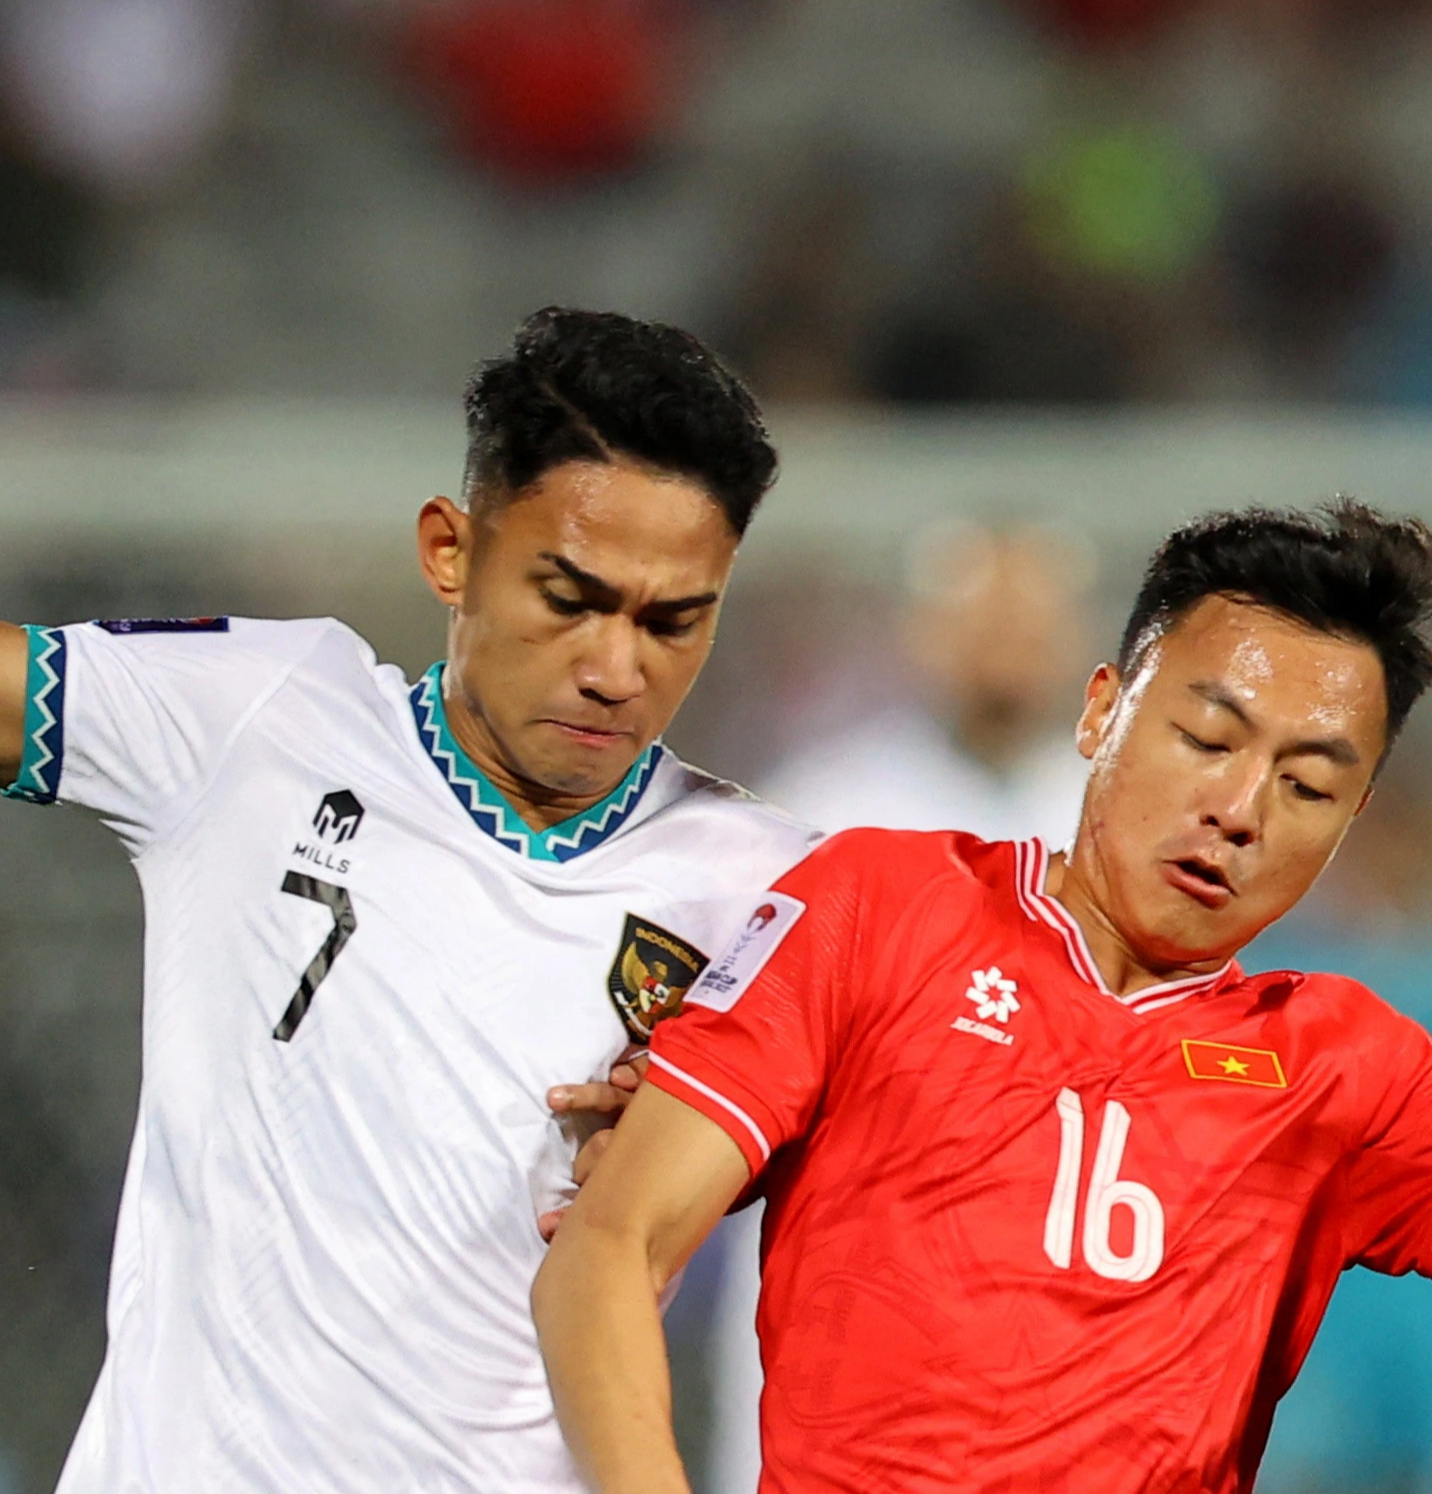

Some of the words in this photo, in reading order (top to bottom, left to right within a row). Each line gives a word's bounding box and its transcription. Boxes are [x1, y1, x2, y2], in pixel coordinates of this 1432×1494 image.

[292, 842, 351, 874] MILLS
[273, 869, 358, 1043] 7
[635, 926, 700, 974] INDONESIA
[1042, 1086, 1165, 1283] 16
